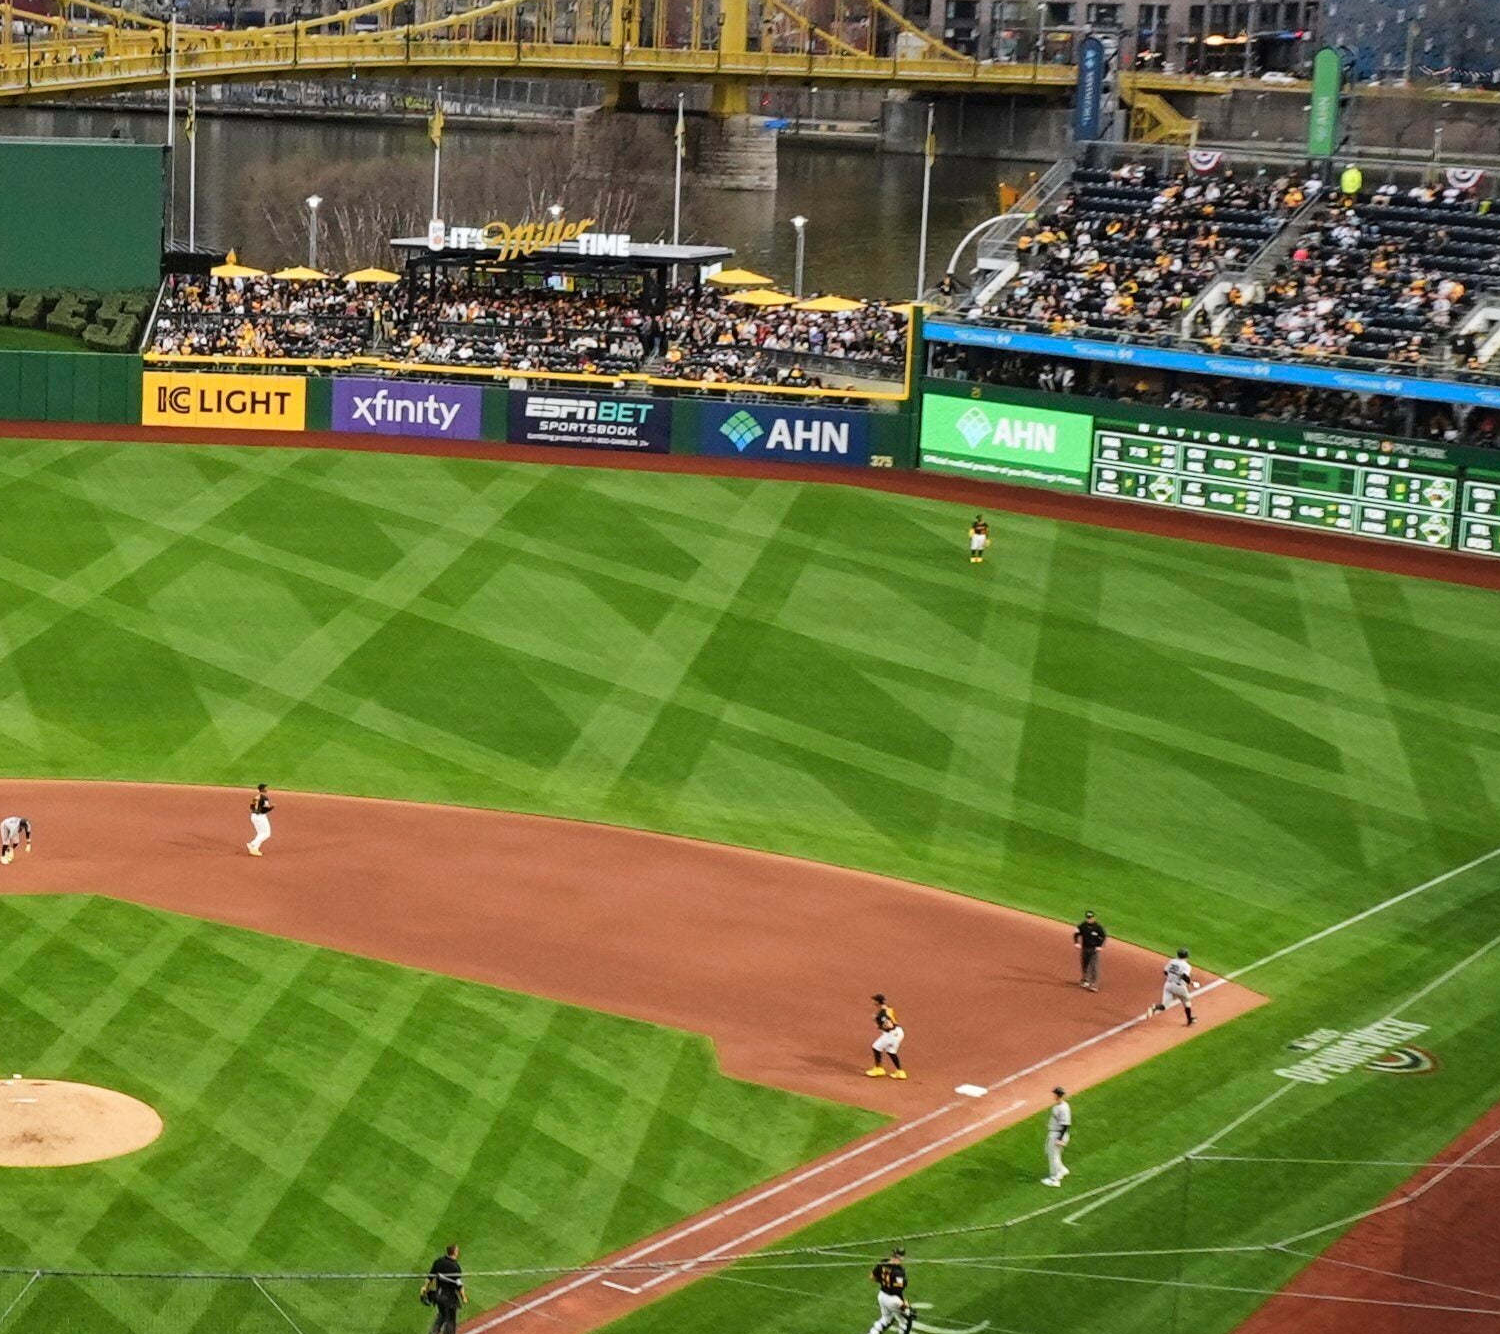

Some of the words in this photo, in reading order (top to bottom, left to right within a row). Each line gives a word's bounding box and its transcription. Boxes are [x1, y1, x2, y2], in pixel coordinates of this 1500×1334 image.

[449, 226, 488, 251] IT'S
[483, 217, 596, 263] Miller
[577, 233, 632, 257] TIME
[156, 386, 191, 414] IC
[199, 389, 292, 416] LIGHT
[350, 389, 462, 431] xfinity
[524, 396, 598, 421] ESPN
[598, 402, 655, 426] BET
[538, 420, 638, 437] SPORTSBOOK
[765, 418, 850, 455] AHN
[992, 416, 1057, 455] AHN
[1303, 431, 1361, 448] WELCOME
[869, 454, 894, 467] 375
[1137, 422, 1278, 452] NATIONAL
[1299, 444, 1411, 469] LEAGUE
